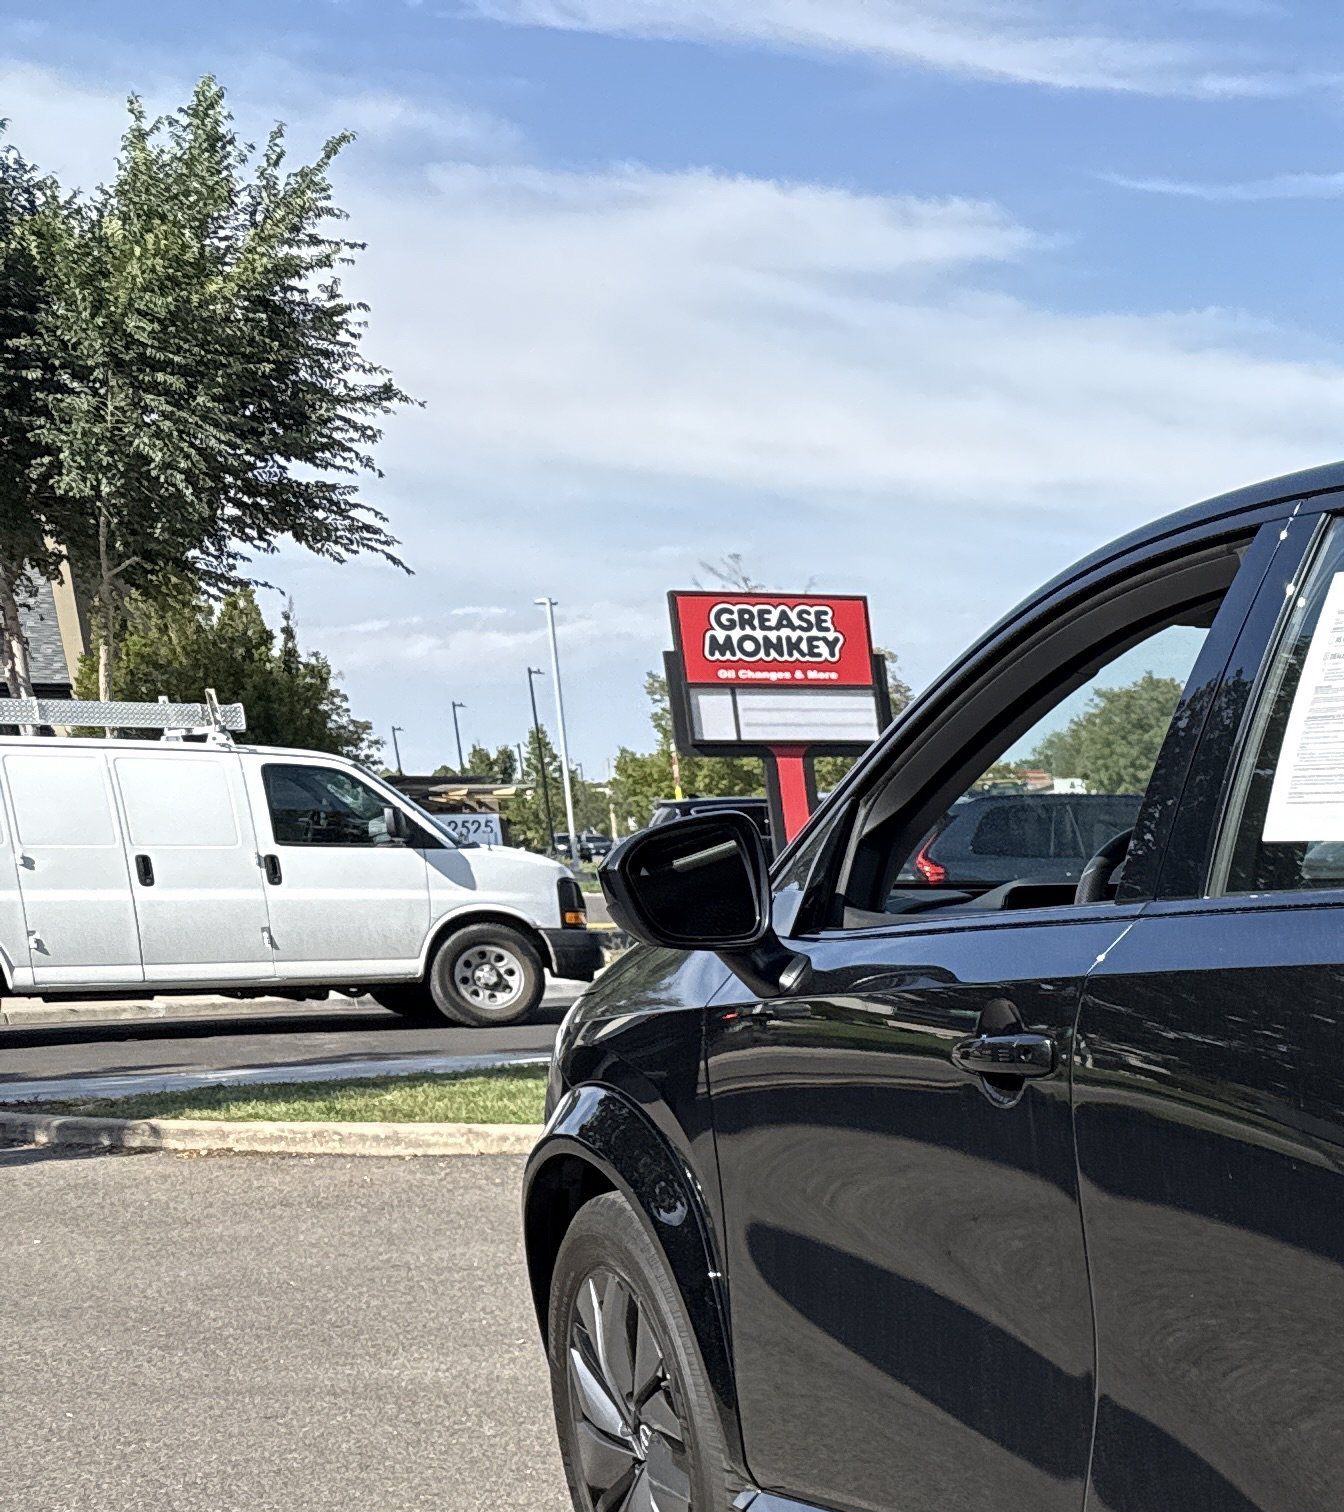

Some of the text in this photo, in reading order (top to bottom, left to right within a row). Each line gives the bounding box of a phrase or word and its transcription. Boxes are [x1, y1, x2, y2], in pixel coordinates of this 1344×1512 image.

[714, 607, 831, 632] GREASE
[708, 634, 841, 659] MONKEY
[717, 668, 839, 681] Oil Changes & More
